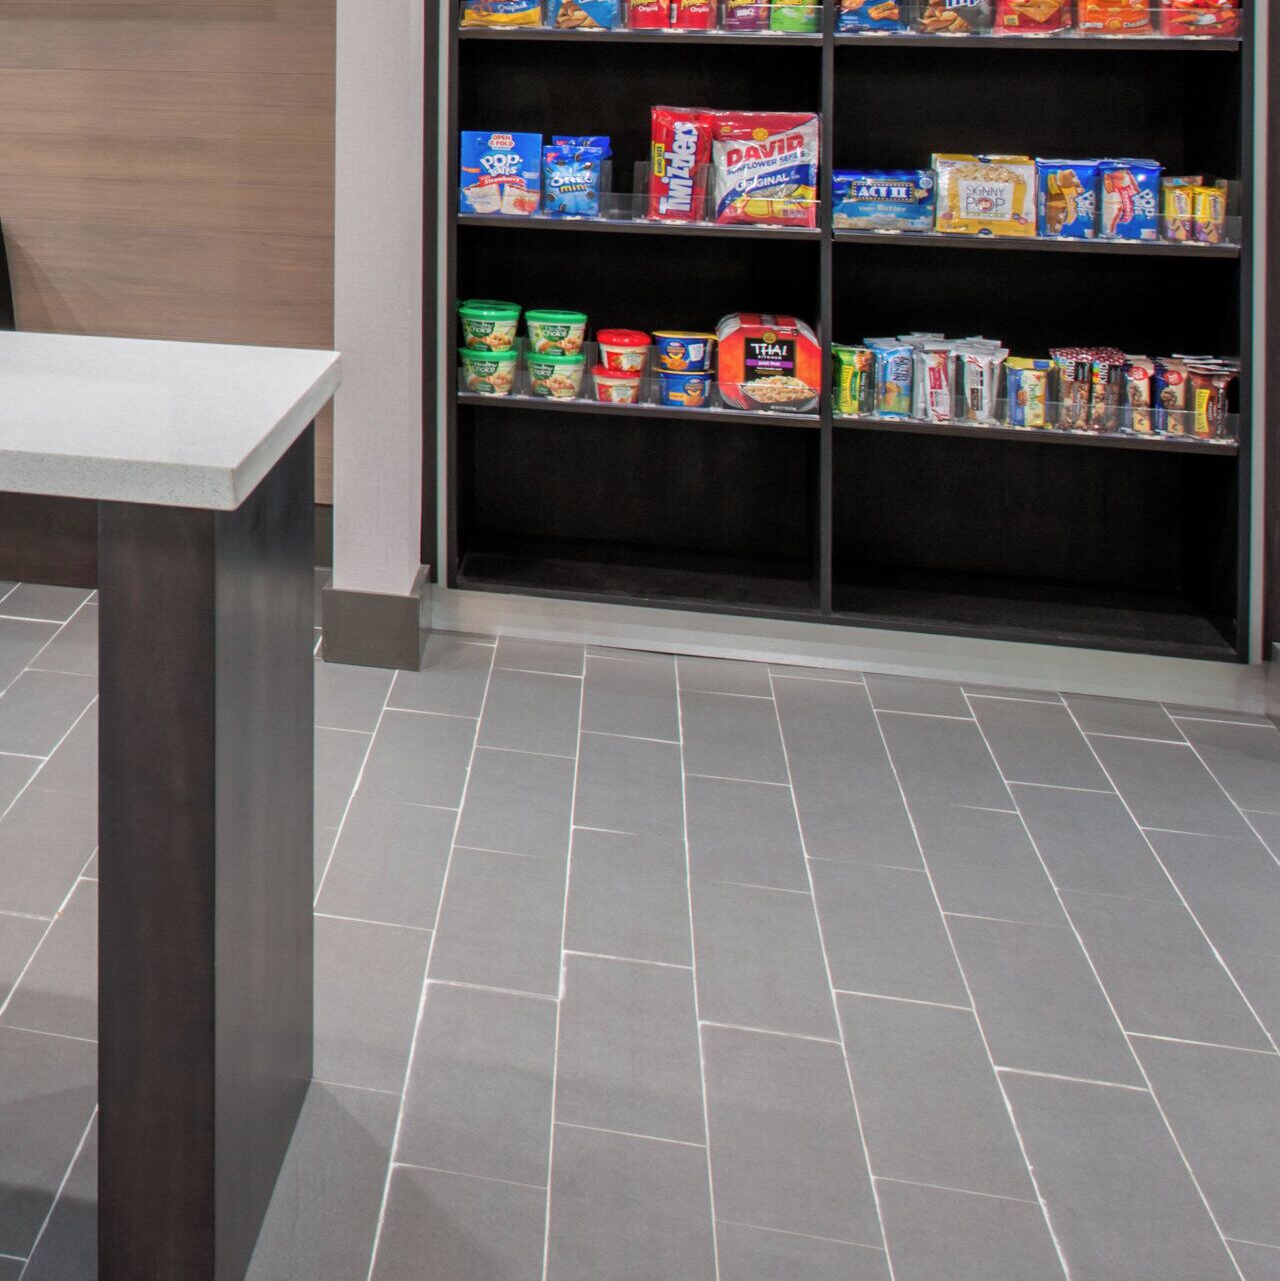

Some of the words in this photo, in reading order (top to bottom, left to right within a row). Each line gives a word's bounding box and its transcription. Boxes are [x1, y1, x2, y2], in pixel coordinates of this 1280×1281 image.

[726, 133, 805, 168] DAVID
[726, 158, 778, 176] SUNFLOWER
[550, 175, 593, 187] OREO
[858, 186, 888, 197] ACT
[966, 185, 1006, 197] SKINNY
[750, 343, 788, 356] THAI
[1066, 360, 1076, 381] KIND
[1099, 362, 1109, 384] KIND
